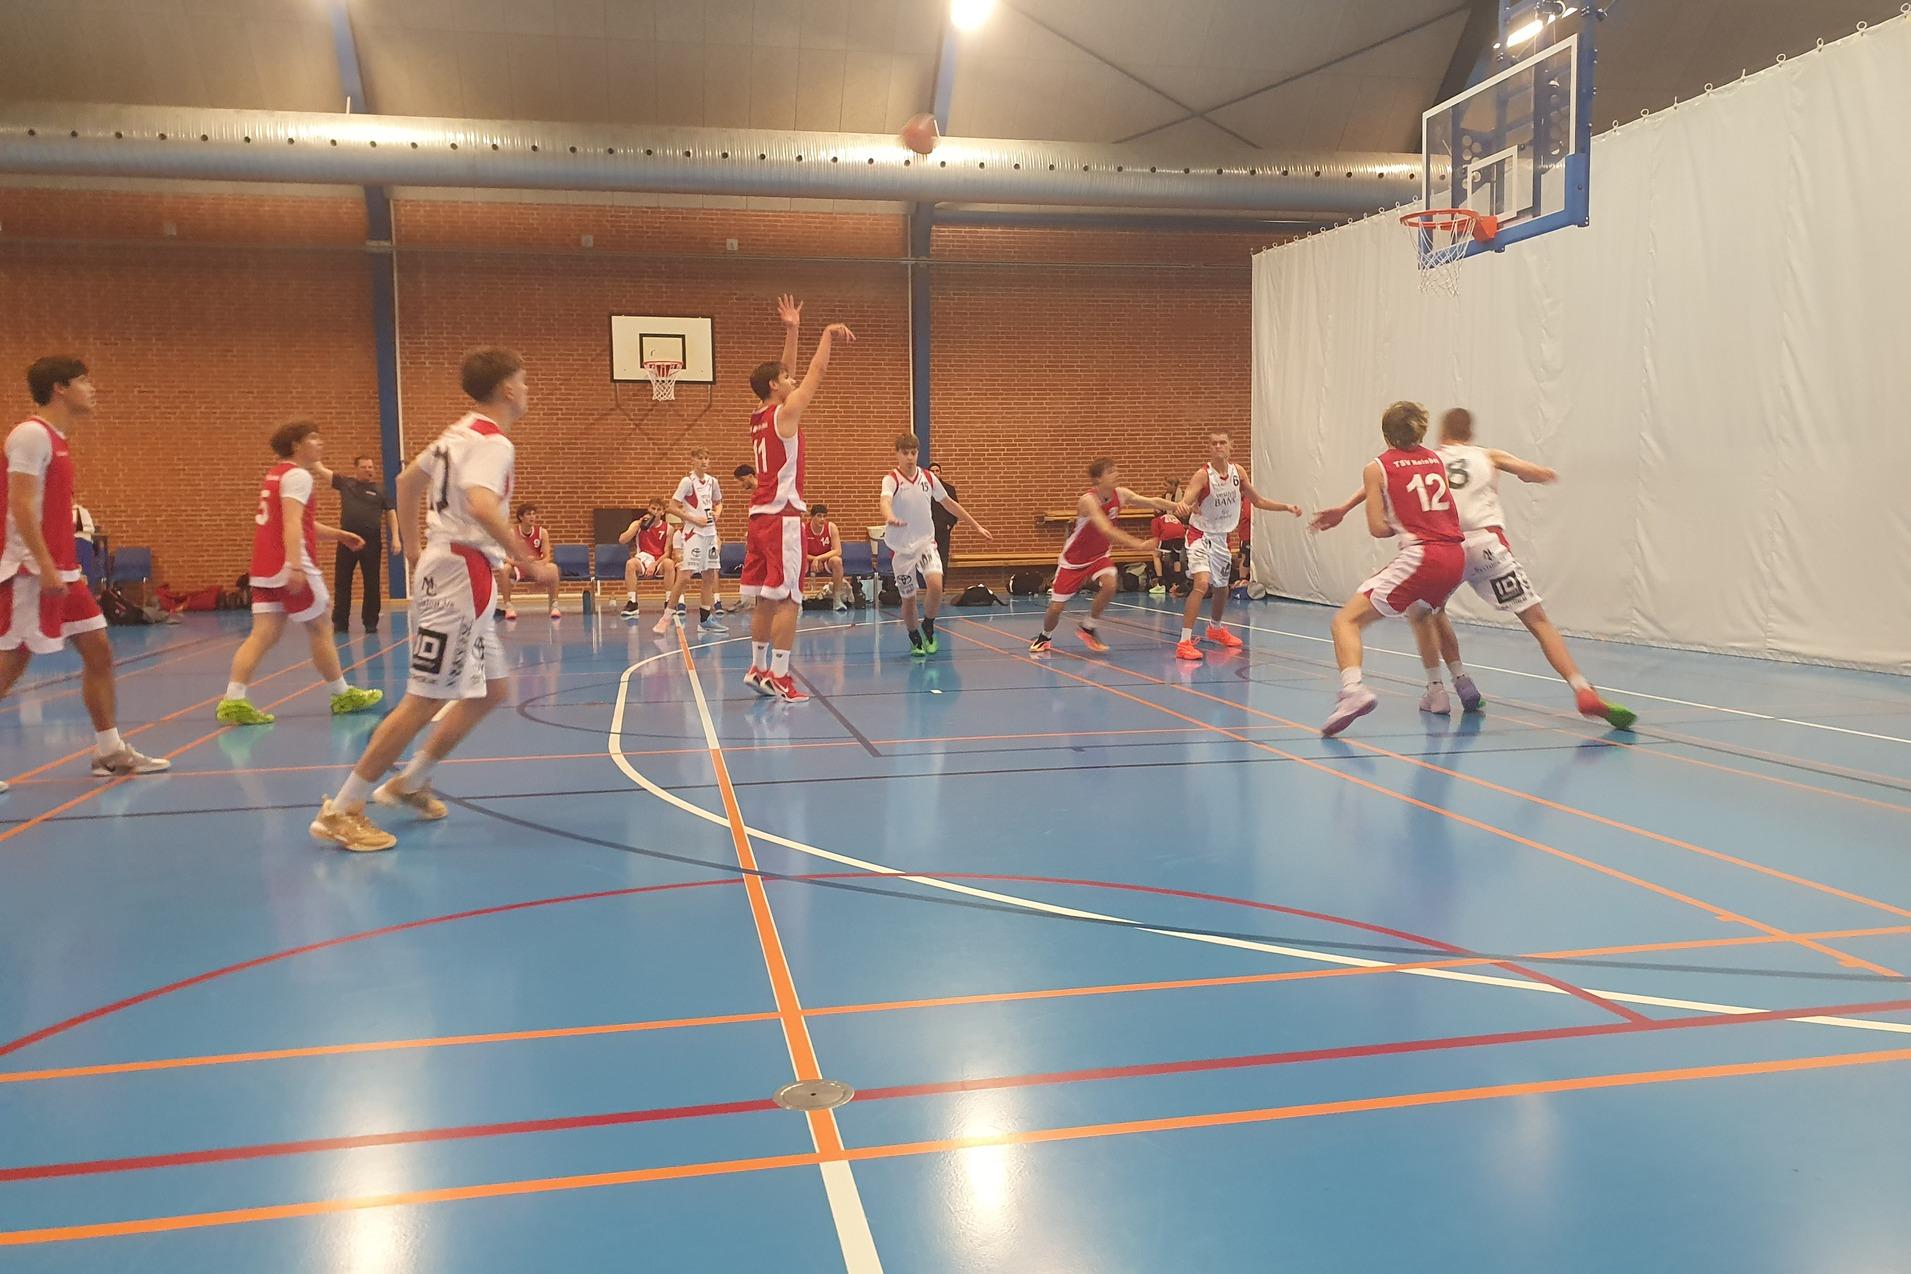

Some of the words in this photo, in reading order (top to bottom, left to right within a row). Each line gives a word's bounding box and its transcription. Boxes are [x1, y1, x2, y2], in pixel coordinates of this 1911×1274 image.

[1232, 474, 1240, 487] 6
[1406, 472, 1450, 512] 12
[658, 530, 665, 541] 7
